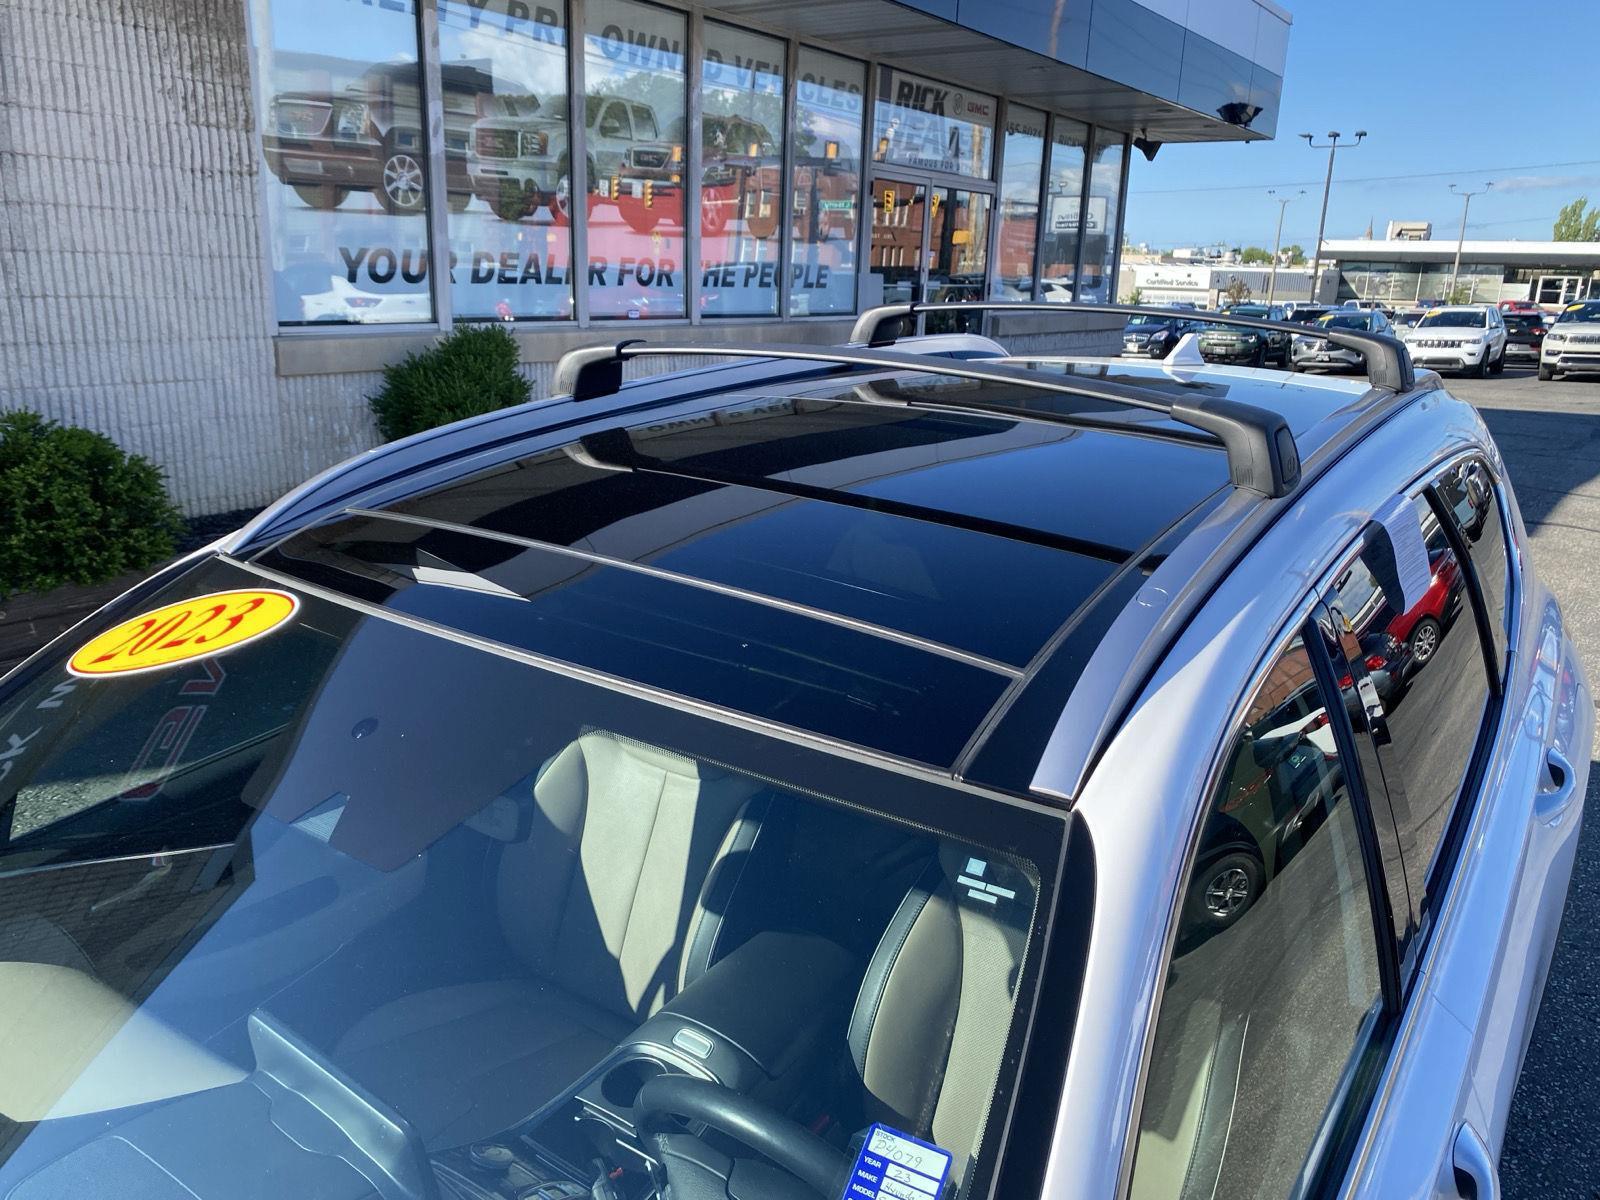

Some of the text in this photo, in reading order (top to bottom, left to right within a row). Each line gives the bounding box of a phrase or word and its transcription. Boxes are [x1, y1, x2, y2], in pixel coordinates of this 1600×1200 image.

[896, 80, 951, 117] RICK
[967, 102, 989, 116] GMC
[470, 250, 609, 287] DEALR
[616, 256, 675, 287] FOR
[700, 260, 736, 289] HE
[87, 597, 265, 665] 2023
[875, 1130, 896, 1142] STOCK
[873, 1139, 923, 1168] P4079
[864, 1155, 882, 1168] YEAR
[857, 1169, 878, 1184] MAKE
[894, 1169, 911, 1183] 23
[852, 1183, 876, 1199] MODEL
